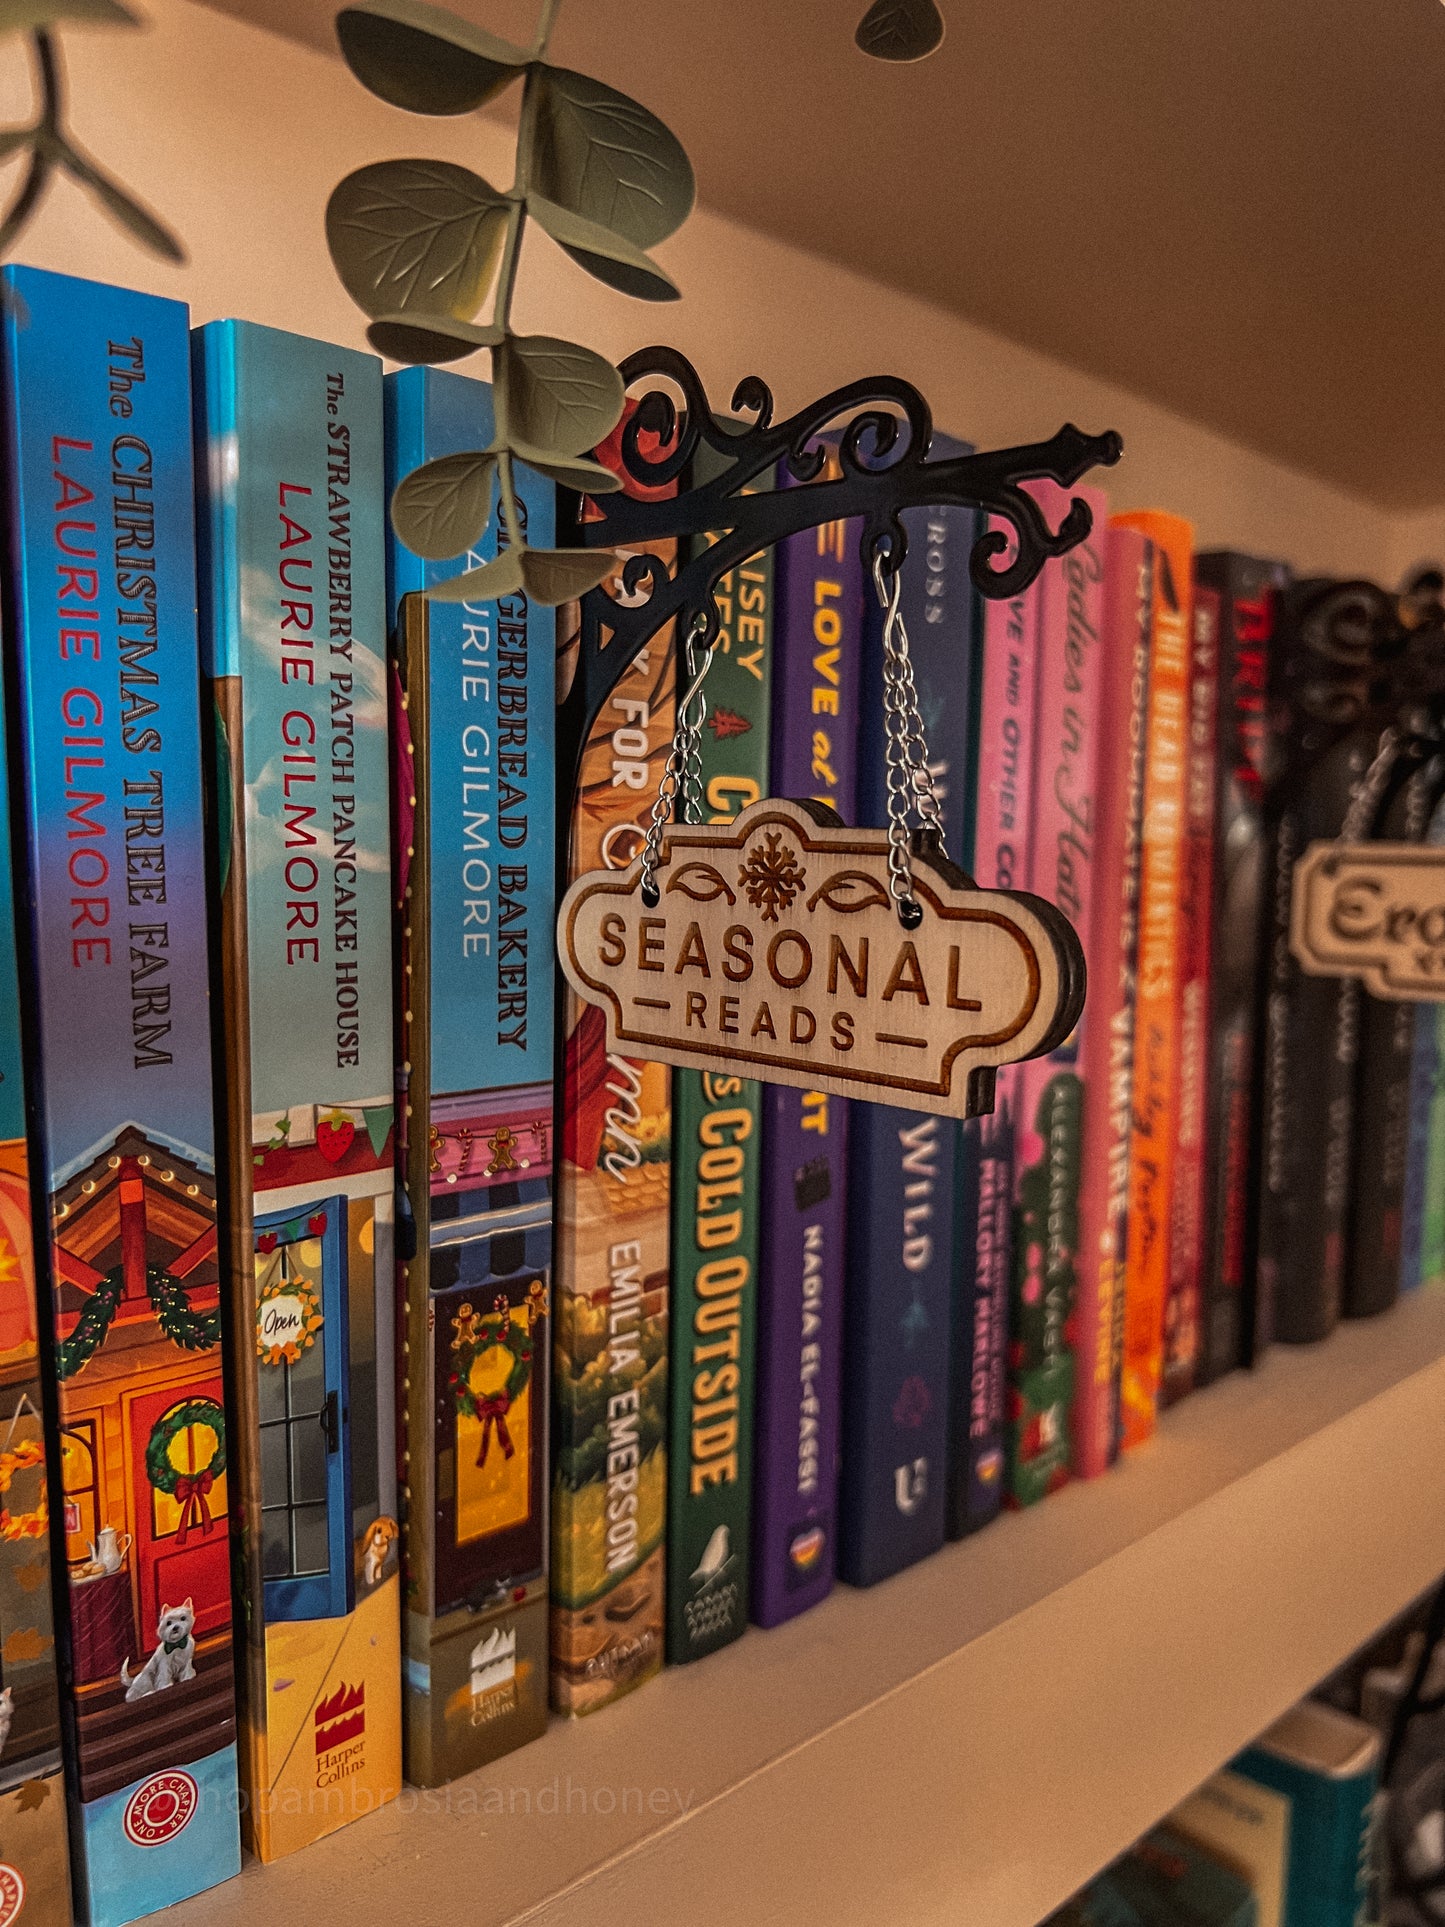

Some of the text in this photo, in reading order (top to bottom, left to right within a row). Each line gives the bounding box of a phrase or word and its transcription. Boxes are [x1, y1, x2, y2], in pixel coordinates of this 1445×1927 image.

[925, 505, 947, 624] ROSS
[51, 435, 112, 968] LAURIE GILMORE
[107, 336, 173, 1070] The CHRISTMAS TREE FARM
[811, 579, 844, 717] LOVE
[279, 482, 320, 966] LAURIE GILMORE
[326, 373, 359, 1069] The STRAWBERRY PATCH PANCAKE HOUSE
[495, 495, 529, 1052] GIGERBREAD BAKERY
[612, 698, 650, 790] FOR
[811, 731, 838, 788] at
[461, 725, 492, 958] GILMORE
[598, 912, 983, 1012] SEASONAL
[684, 991, 855, 1052] READS
[697, 1108, 752, 1250] COLD
[899, 1117, 940, 1272] WILD
[264, 1308, 300, 1336] Open
[690, 1255, 750, 1497] OUTSIDE
[606, 1238, 641, 1574] EMILIA EMERSON
[133, 1779, 190, 1838] ONE MORE CHAPTER
[316, 1741, 365, 1774] Harper
[316, 1758, 366, 1788] Collins
